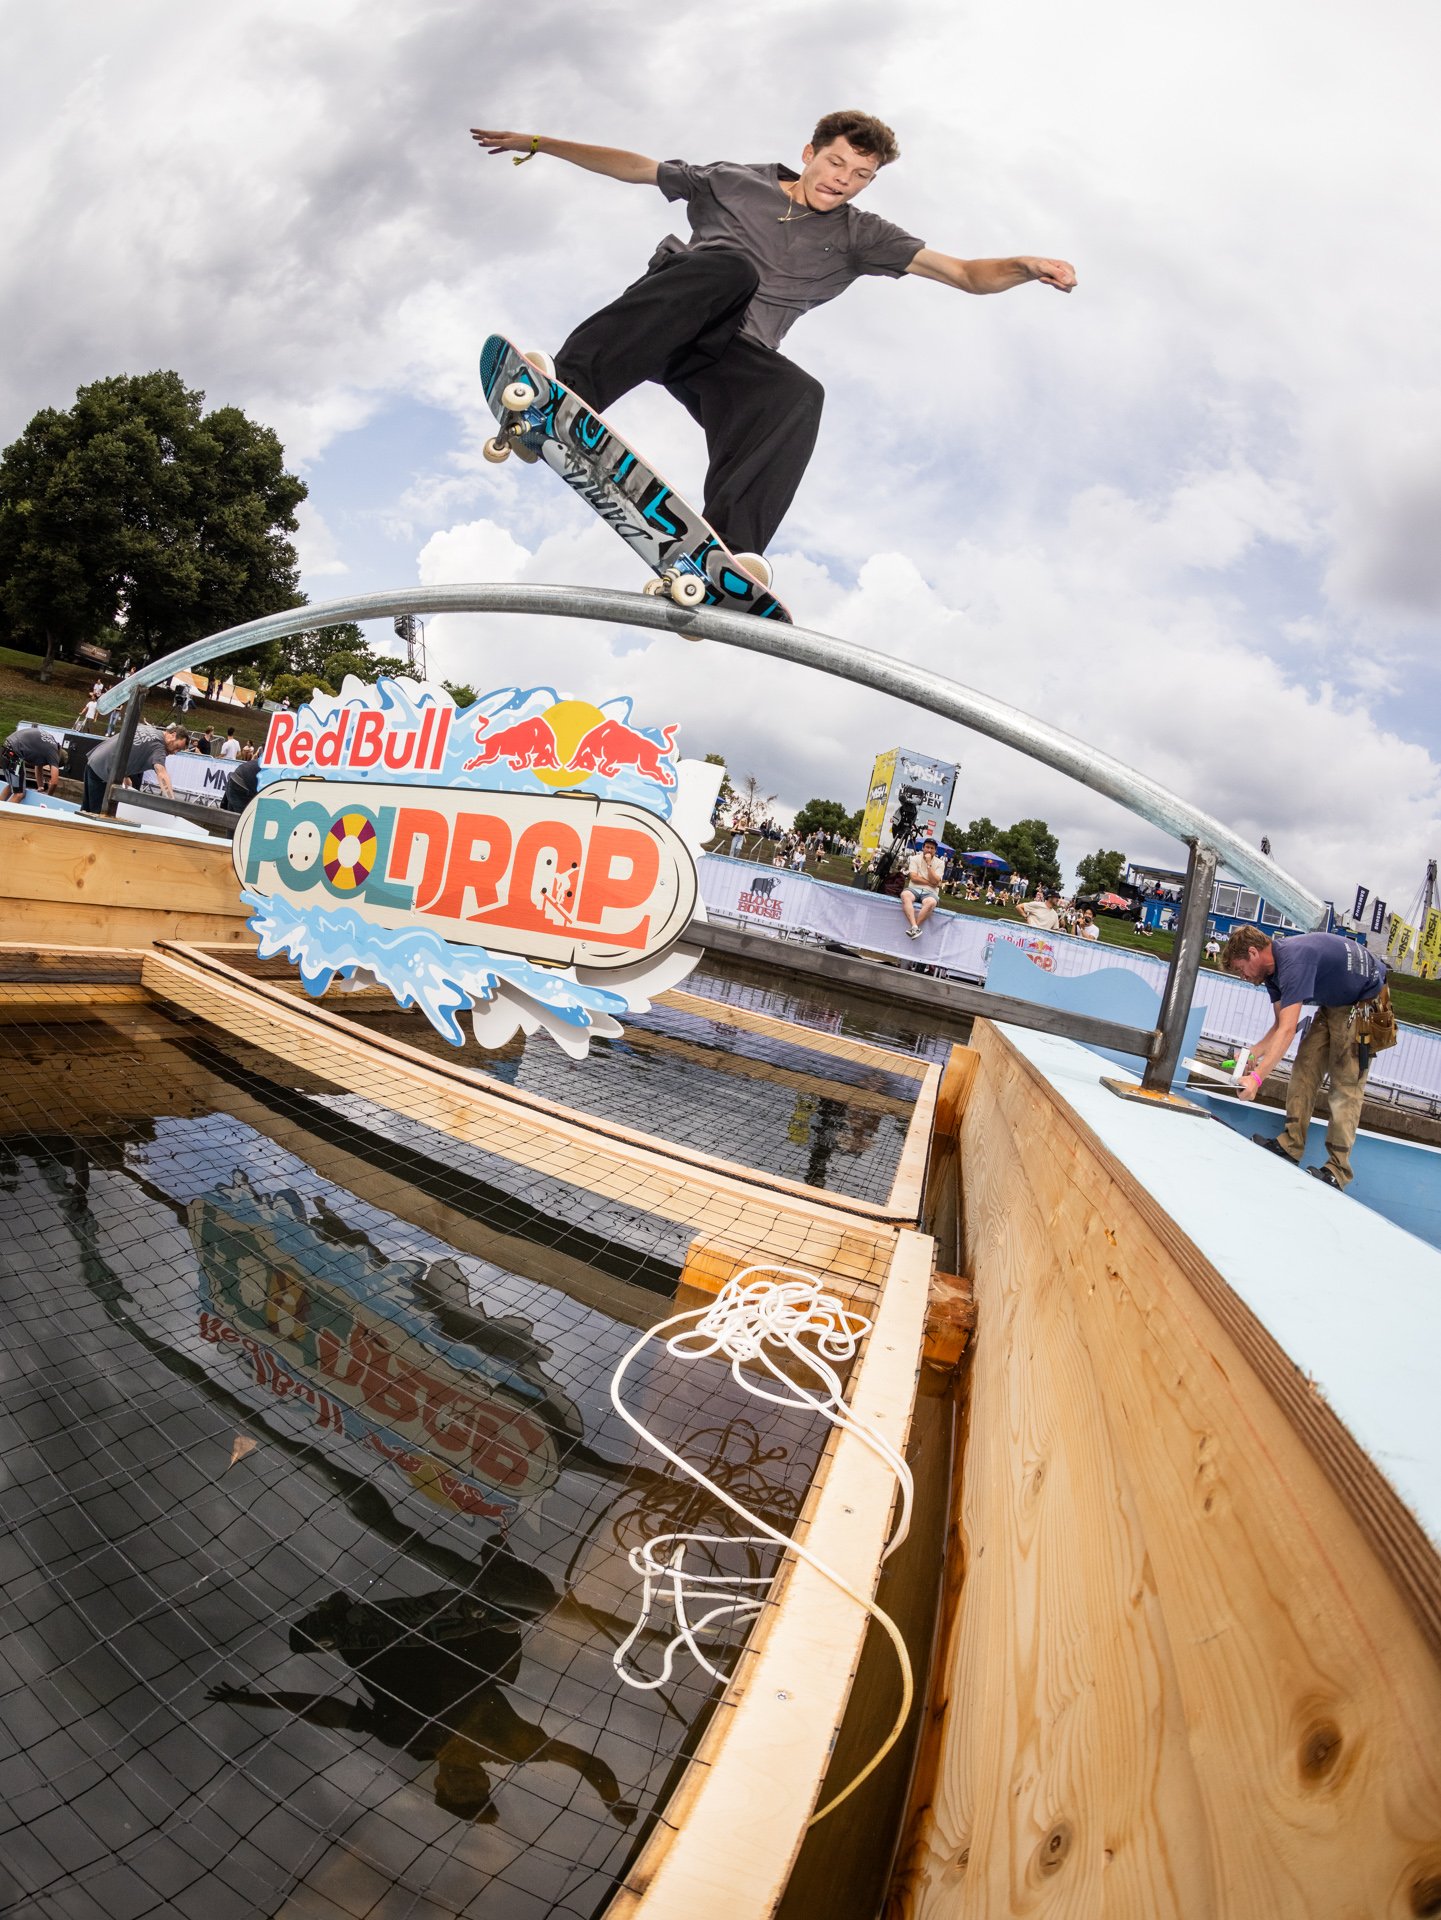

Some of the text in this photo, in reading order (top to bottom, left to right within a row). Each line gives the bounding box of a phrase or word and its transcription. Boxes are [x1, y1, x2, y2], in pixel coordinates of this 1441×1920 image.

[263, 707, 452, 771] Red Bull
[244, 797, 661, 950] POOL DROP
[736, 900, 782, 921] HOUSE
[738, 891, 784, 911] BLOCK
[1374, 903, 1383, 931] SAMSUNG
[1397, 926, 1413, 960] MASH
[1424, 912, 1440, 948] MASH
